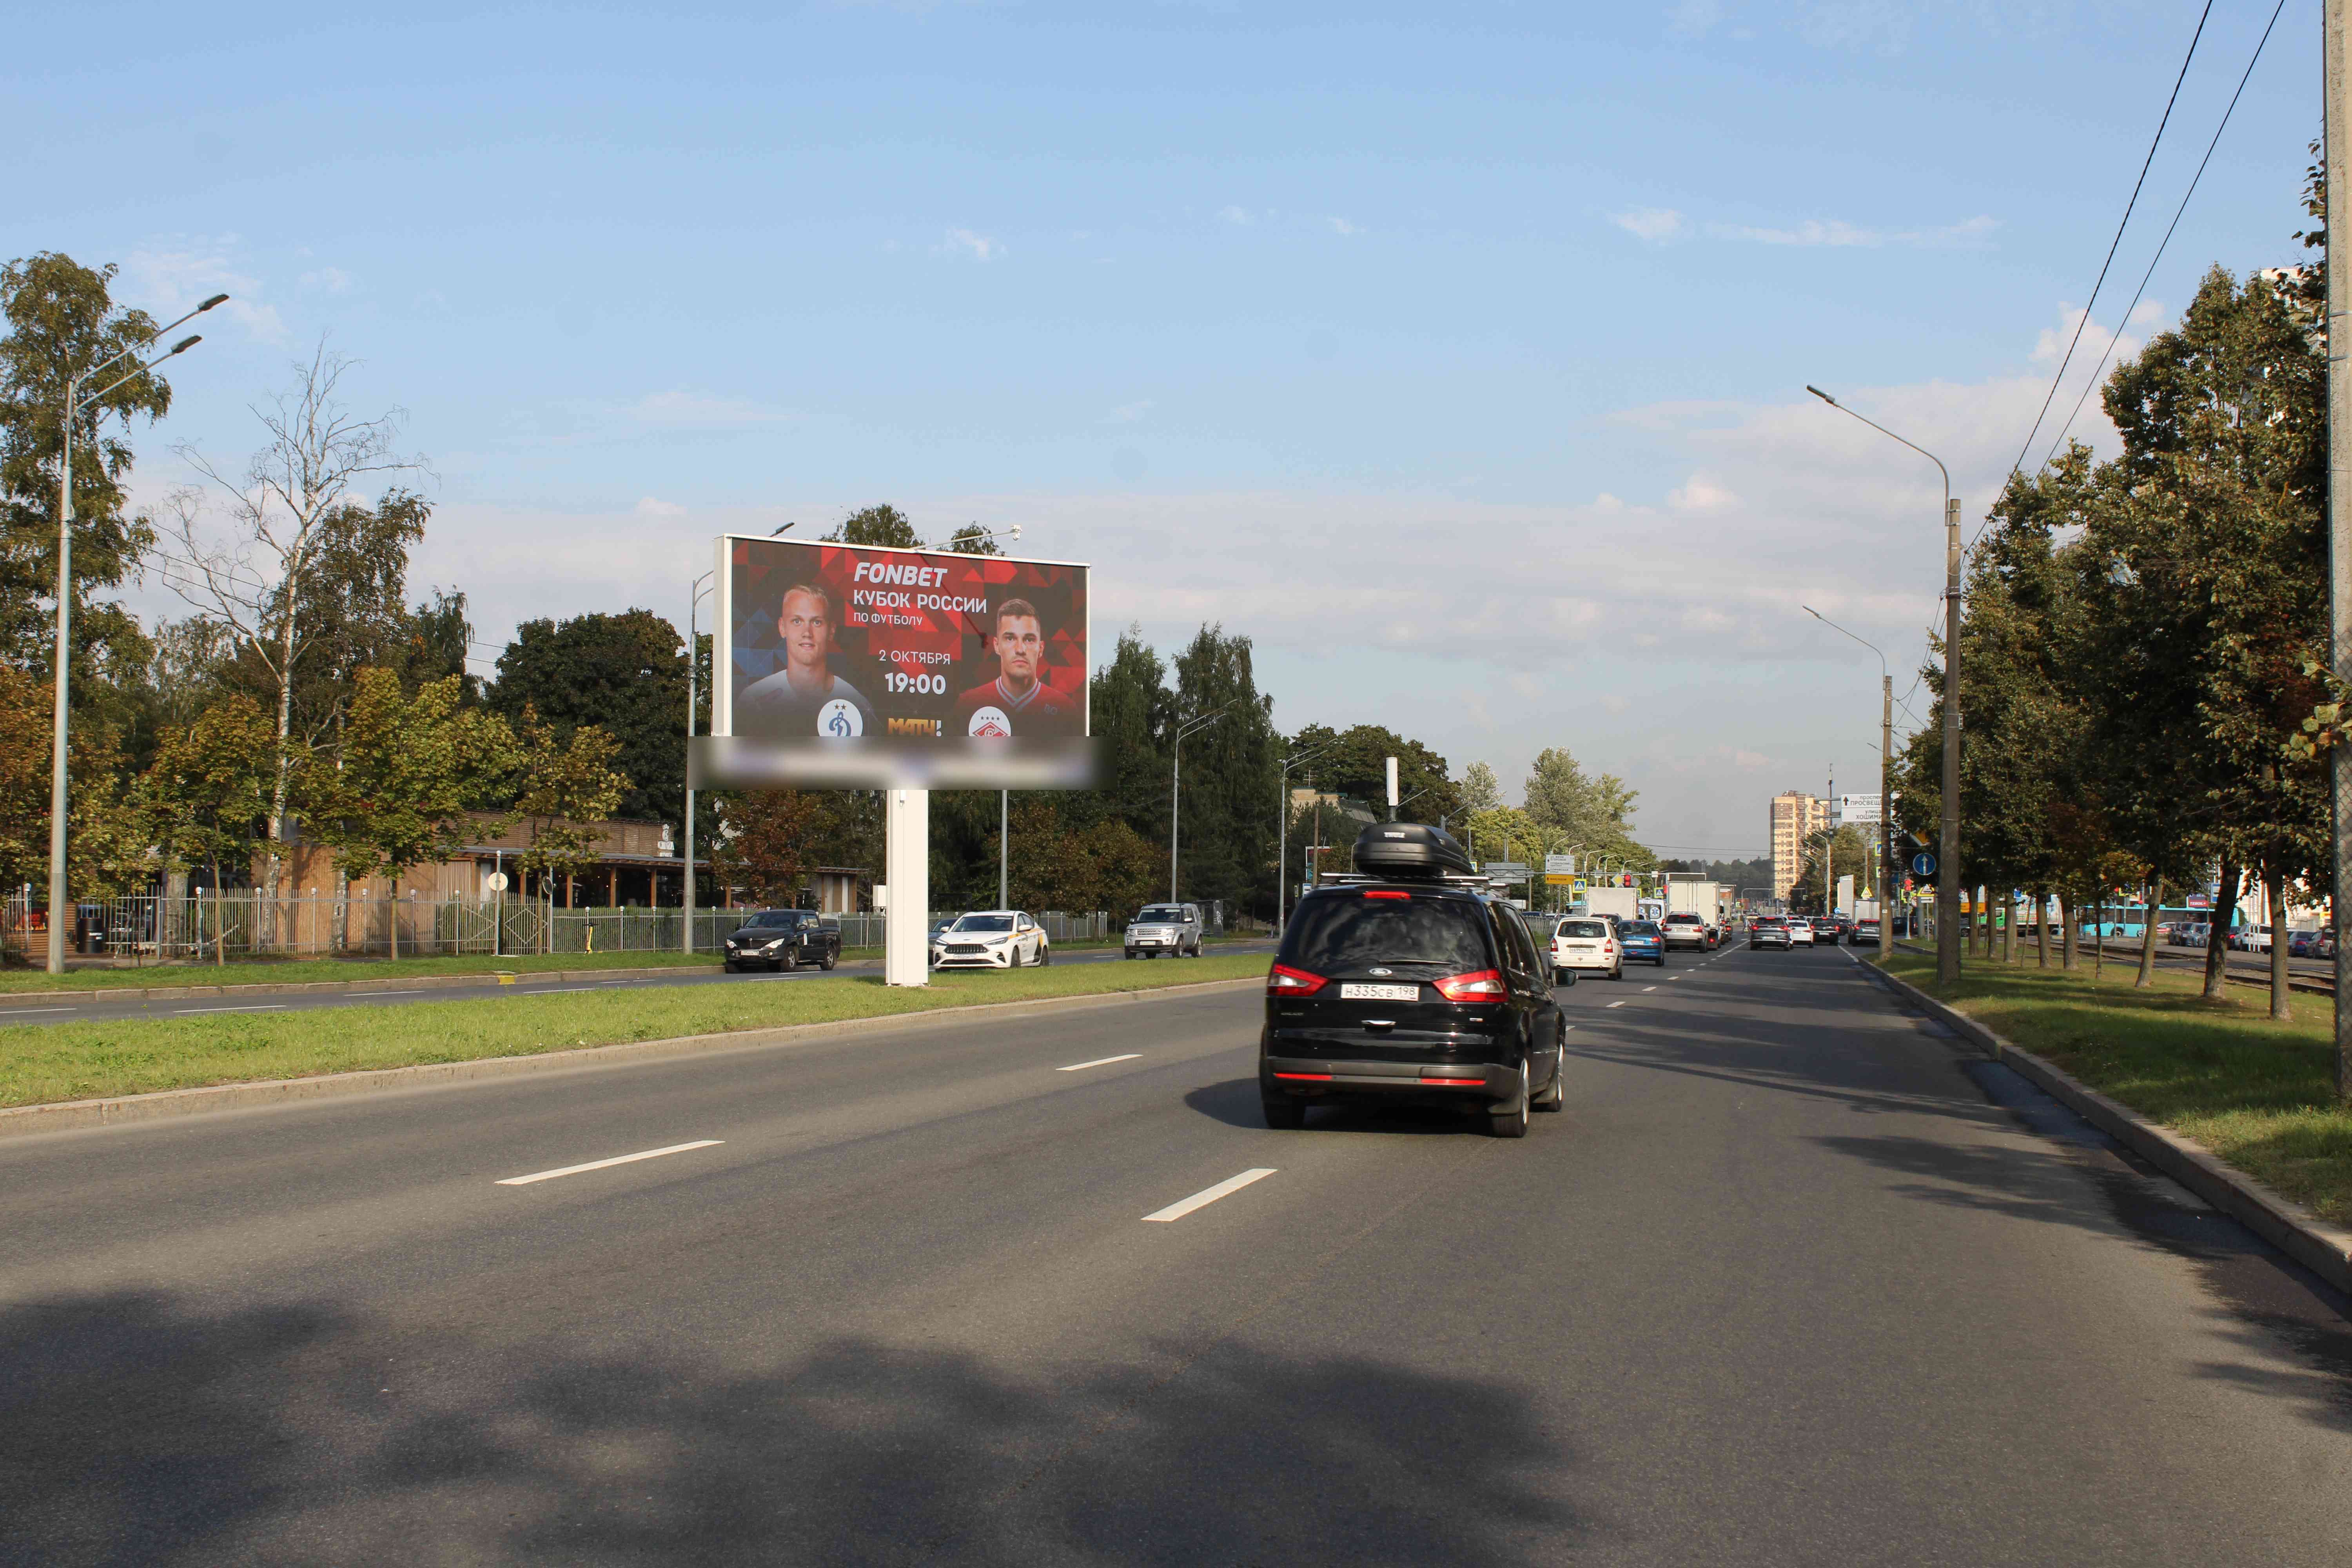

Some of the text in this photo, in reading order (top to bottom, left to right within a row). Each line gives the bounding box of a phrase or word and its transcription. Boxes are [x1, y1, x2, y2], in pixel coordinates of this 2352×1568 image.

[854, 562, 948, 587] FONBET
[854, 590, 987, 613] КУБОК РОССИИ
[854, 612, 922, 626] ПО ФУТБОЛУ
[879, 650, 951, 665] 2 ОКТЯБРЯ
[885, 672, 946, 694] 19:00
[1397, 987, 1415, 995] 198
